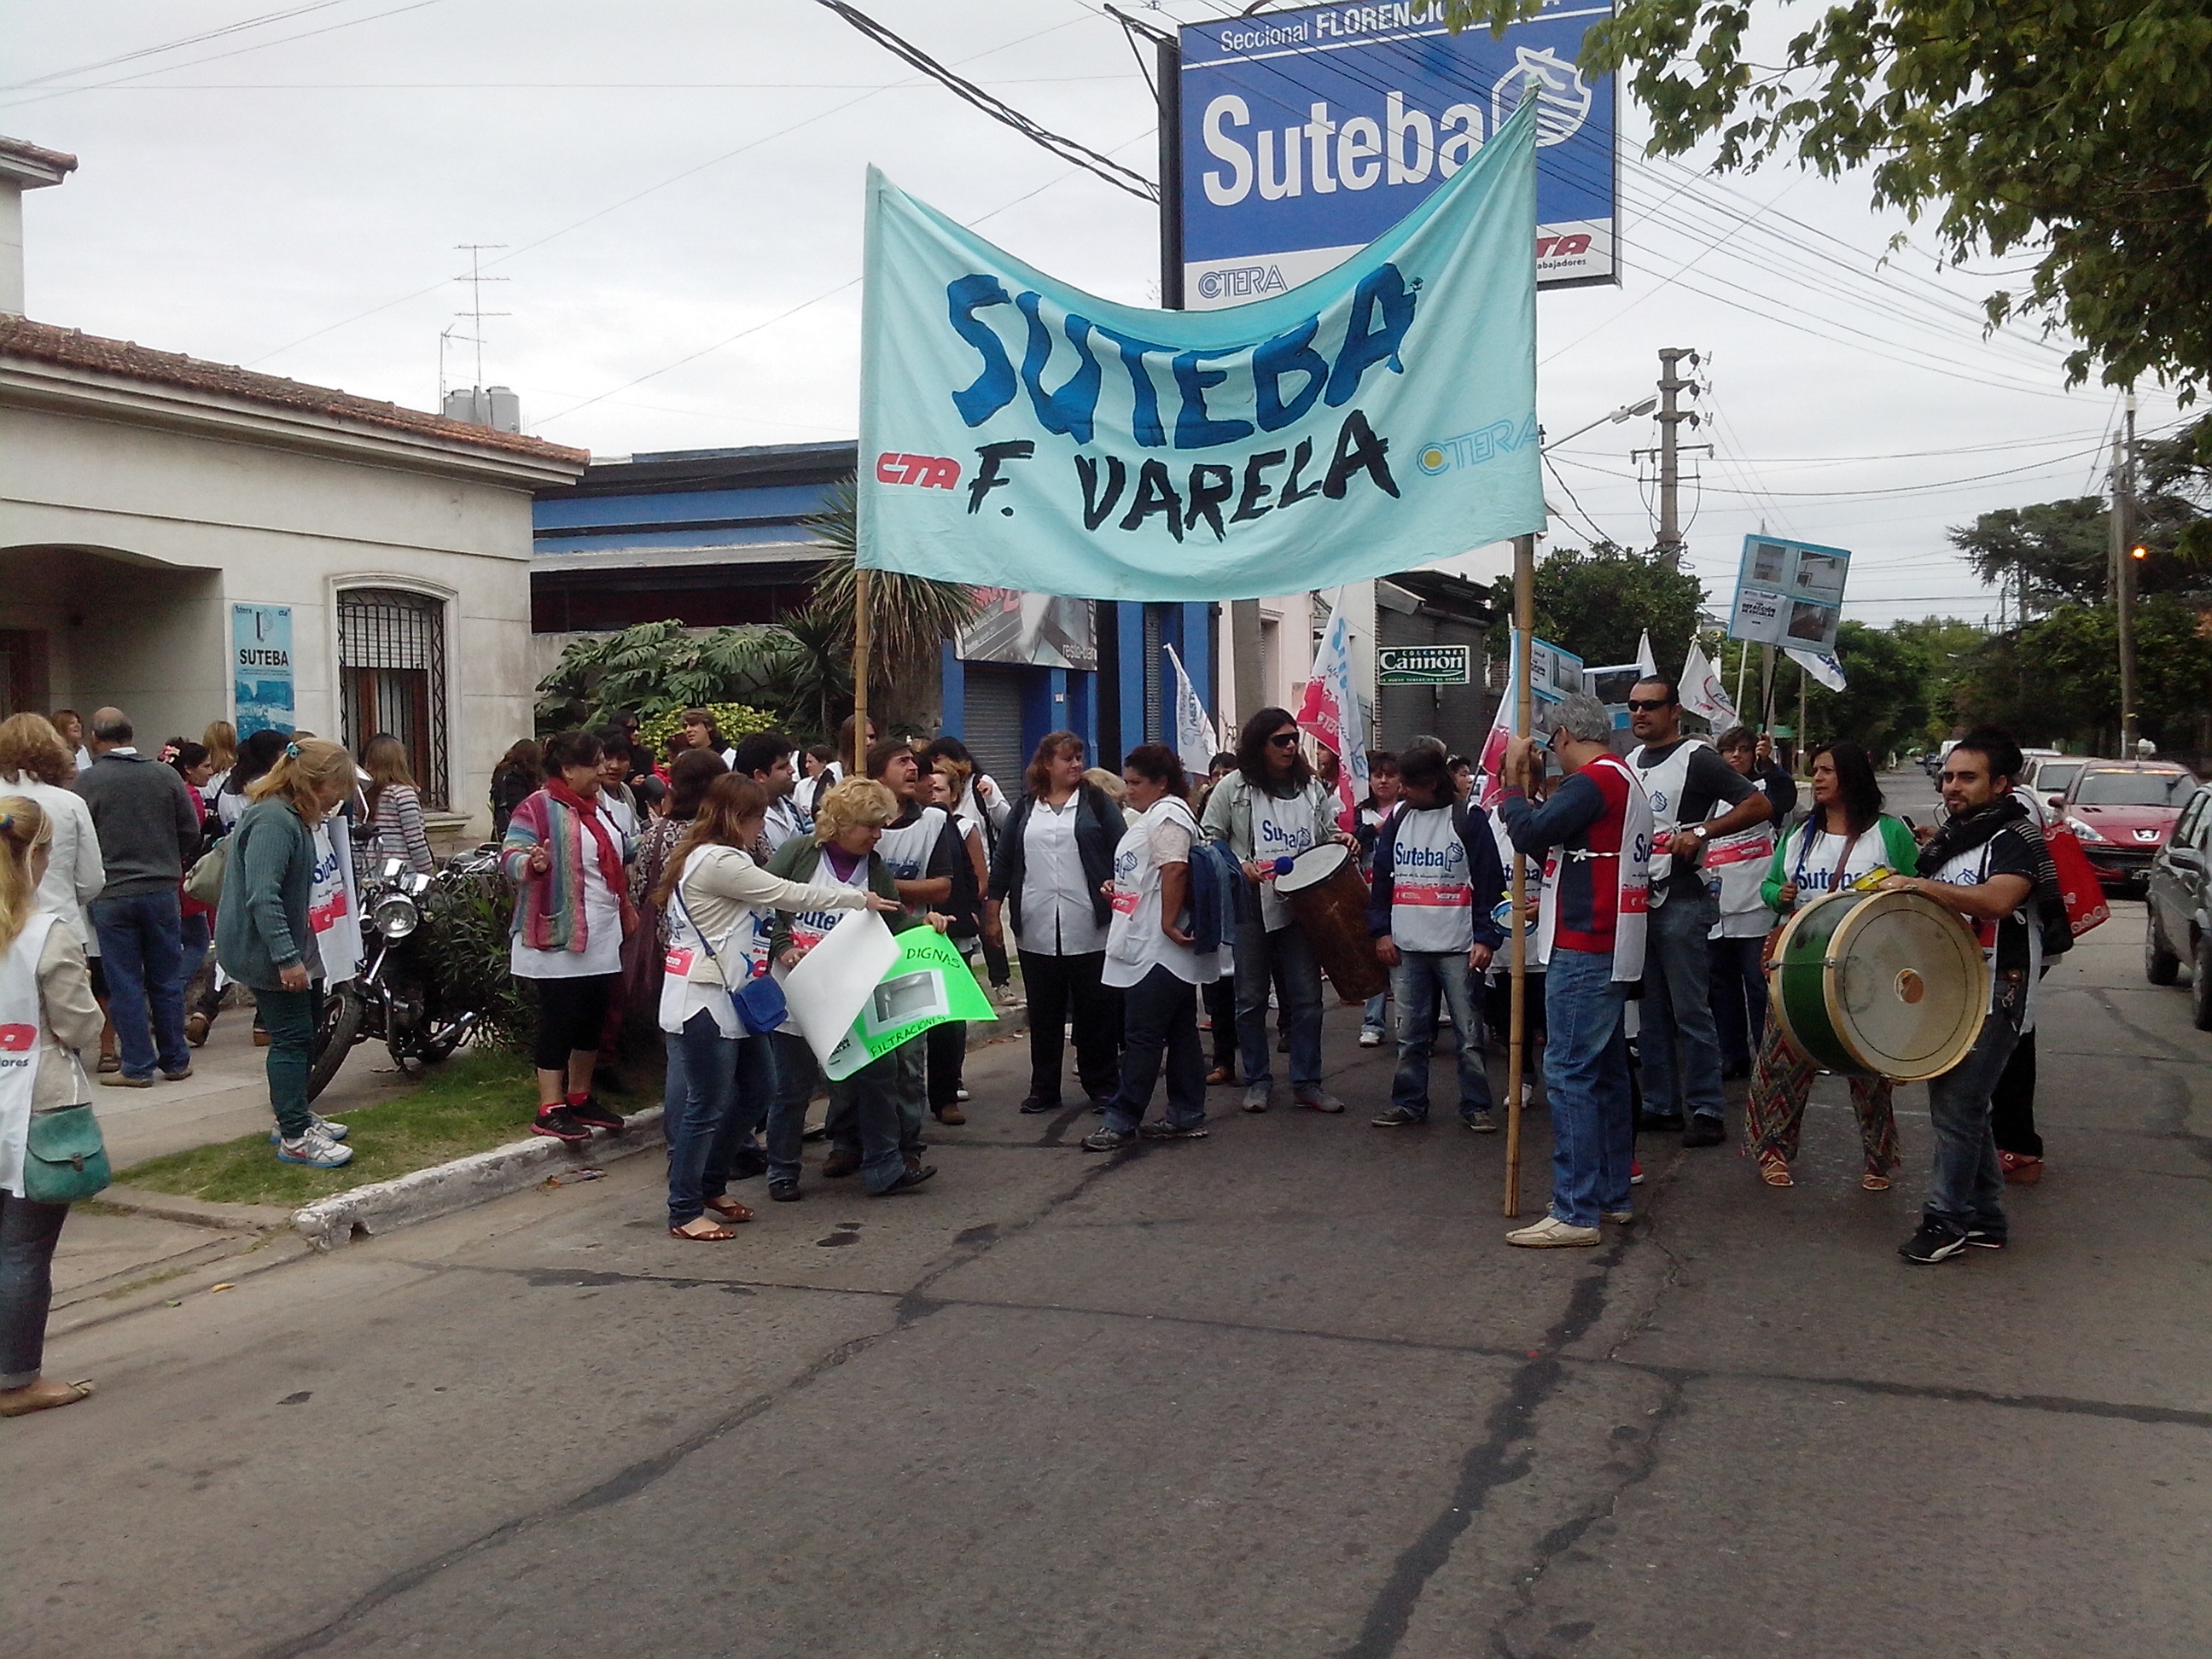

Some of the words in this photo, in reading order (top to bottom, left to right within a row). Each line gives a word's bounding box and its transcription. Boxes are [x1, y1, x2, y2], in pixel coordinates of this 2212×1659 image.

[1220, 20, 1309, 52] Seccional
[1202, 91, 1484, 207] Suteba
[1197, 265, 1289, 299] CTERA
[947, 262, 1417, 450] SUTEBA
[1417, 413, 1539, 475] CTERA
[877, 452, 961, 490] CTA
[968, 439, 1035, 516] F.
[1074, 409, 1401, 543] VARELA
[239, 649, 289, 667] SUTEBA
[1380, 652, 1464, 670] Cannon
[1395, 841, 1444, 867] Suteba
[906, 947, 961, 969] DIGNAS
[870, 1014, 946, 1057] FILTRACIONES
